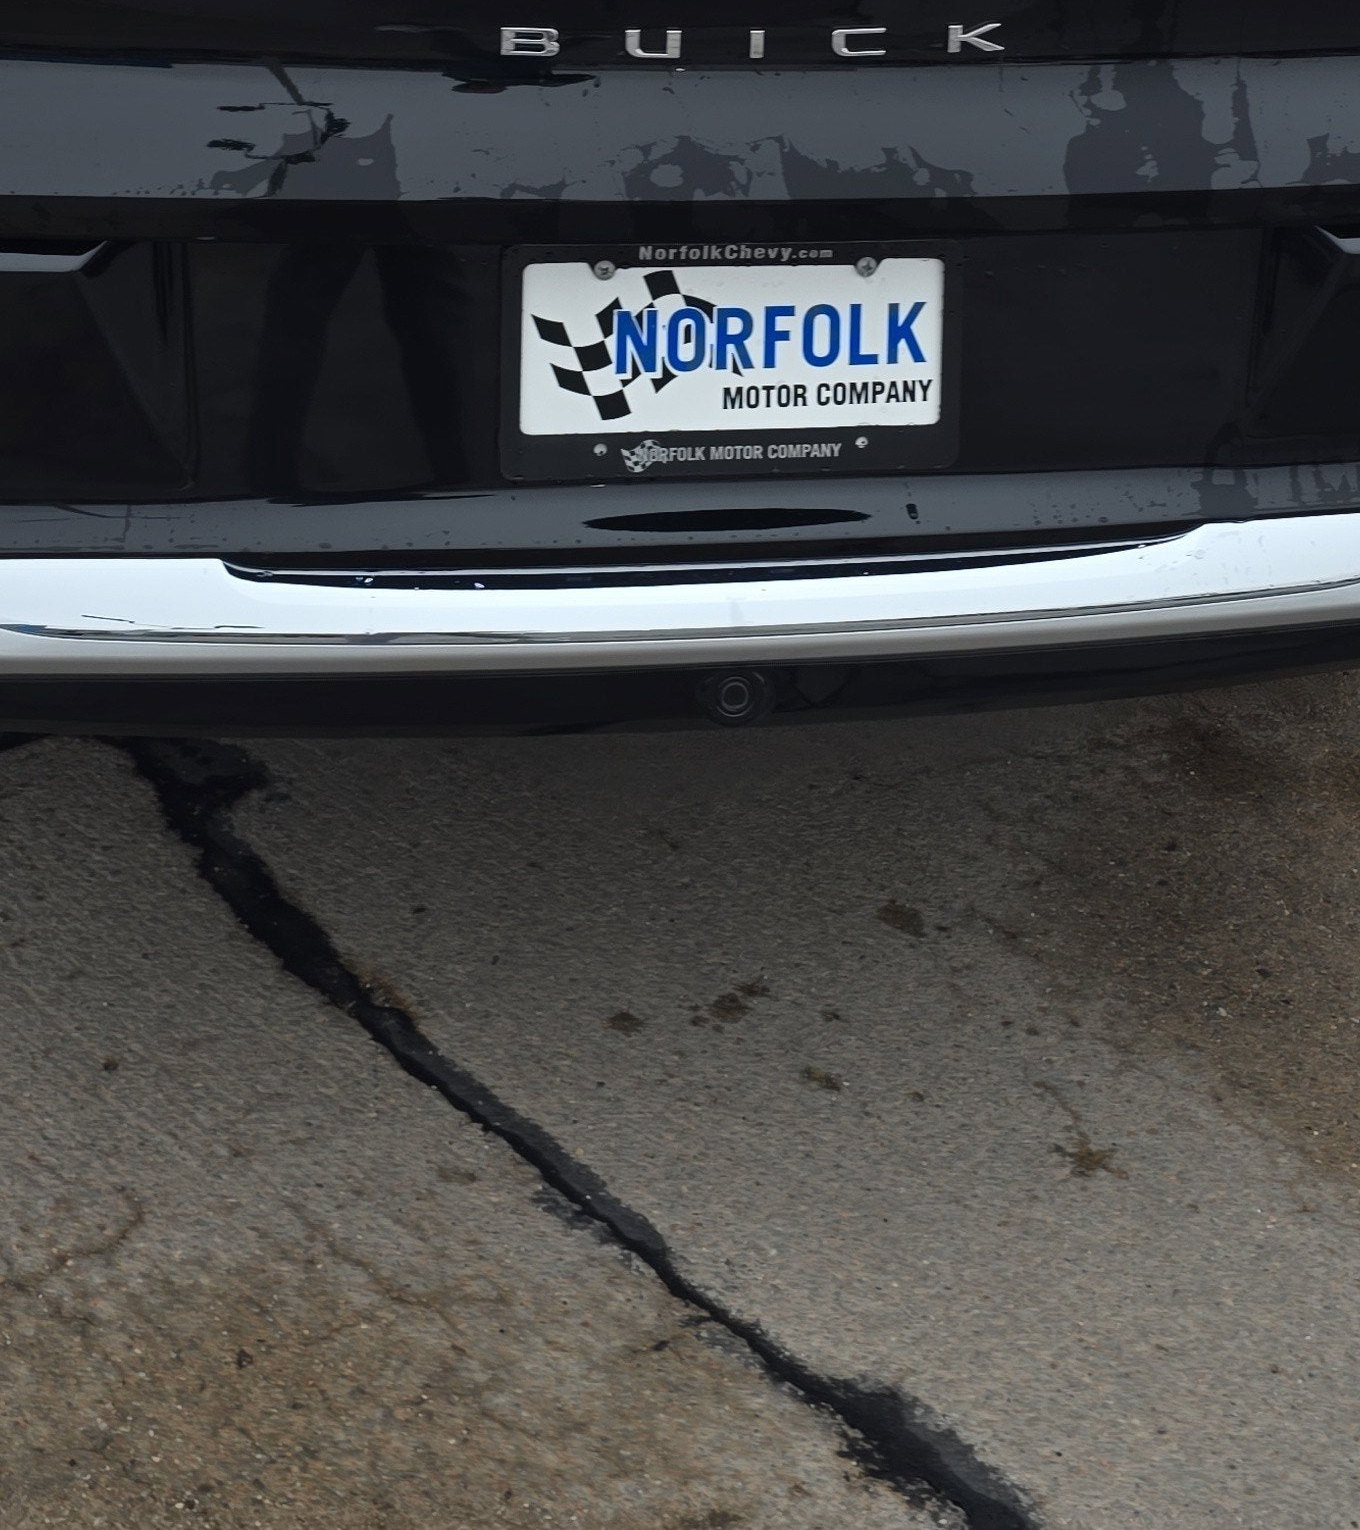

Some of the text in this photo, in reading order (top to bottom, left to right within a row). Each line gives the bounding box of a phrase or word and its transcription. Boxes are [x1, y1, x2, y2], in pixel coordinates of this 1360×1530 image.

[500, 23, 1005, 59] BUICK
[638, 244, 834, 262] NorfolkChevy.com
[614, 301, 927, 375] NORFOLK
[723, 379, 933, 410] MOTOR COMPANY
[637, 442, 842, 463] NORFOLK MOTOR COMPANY
